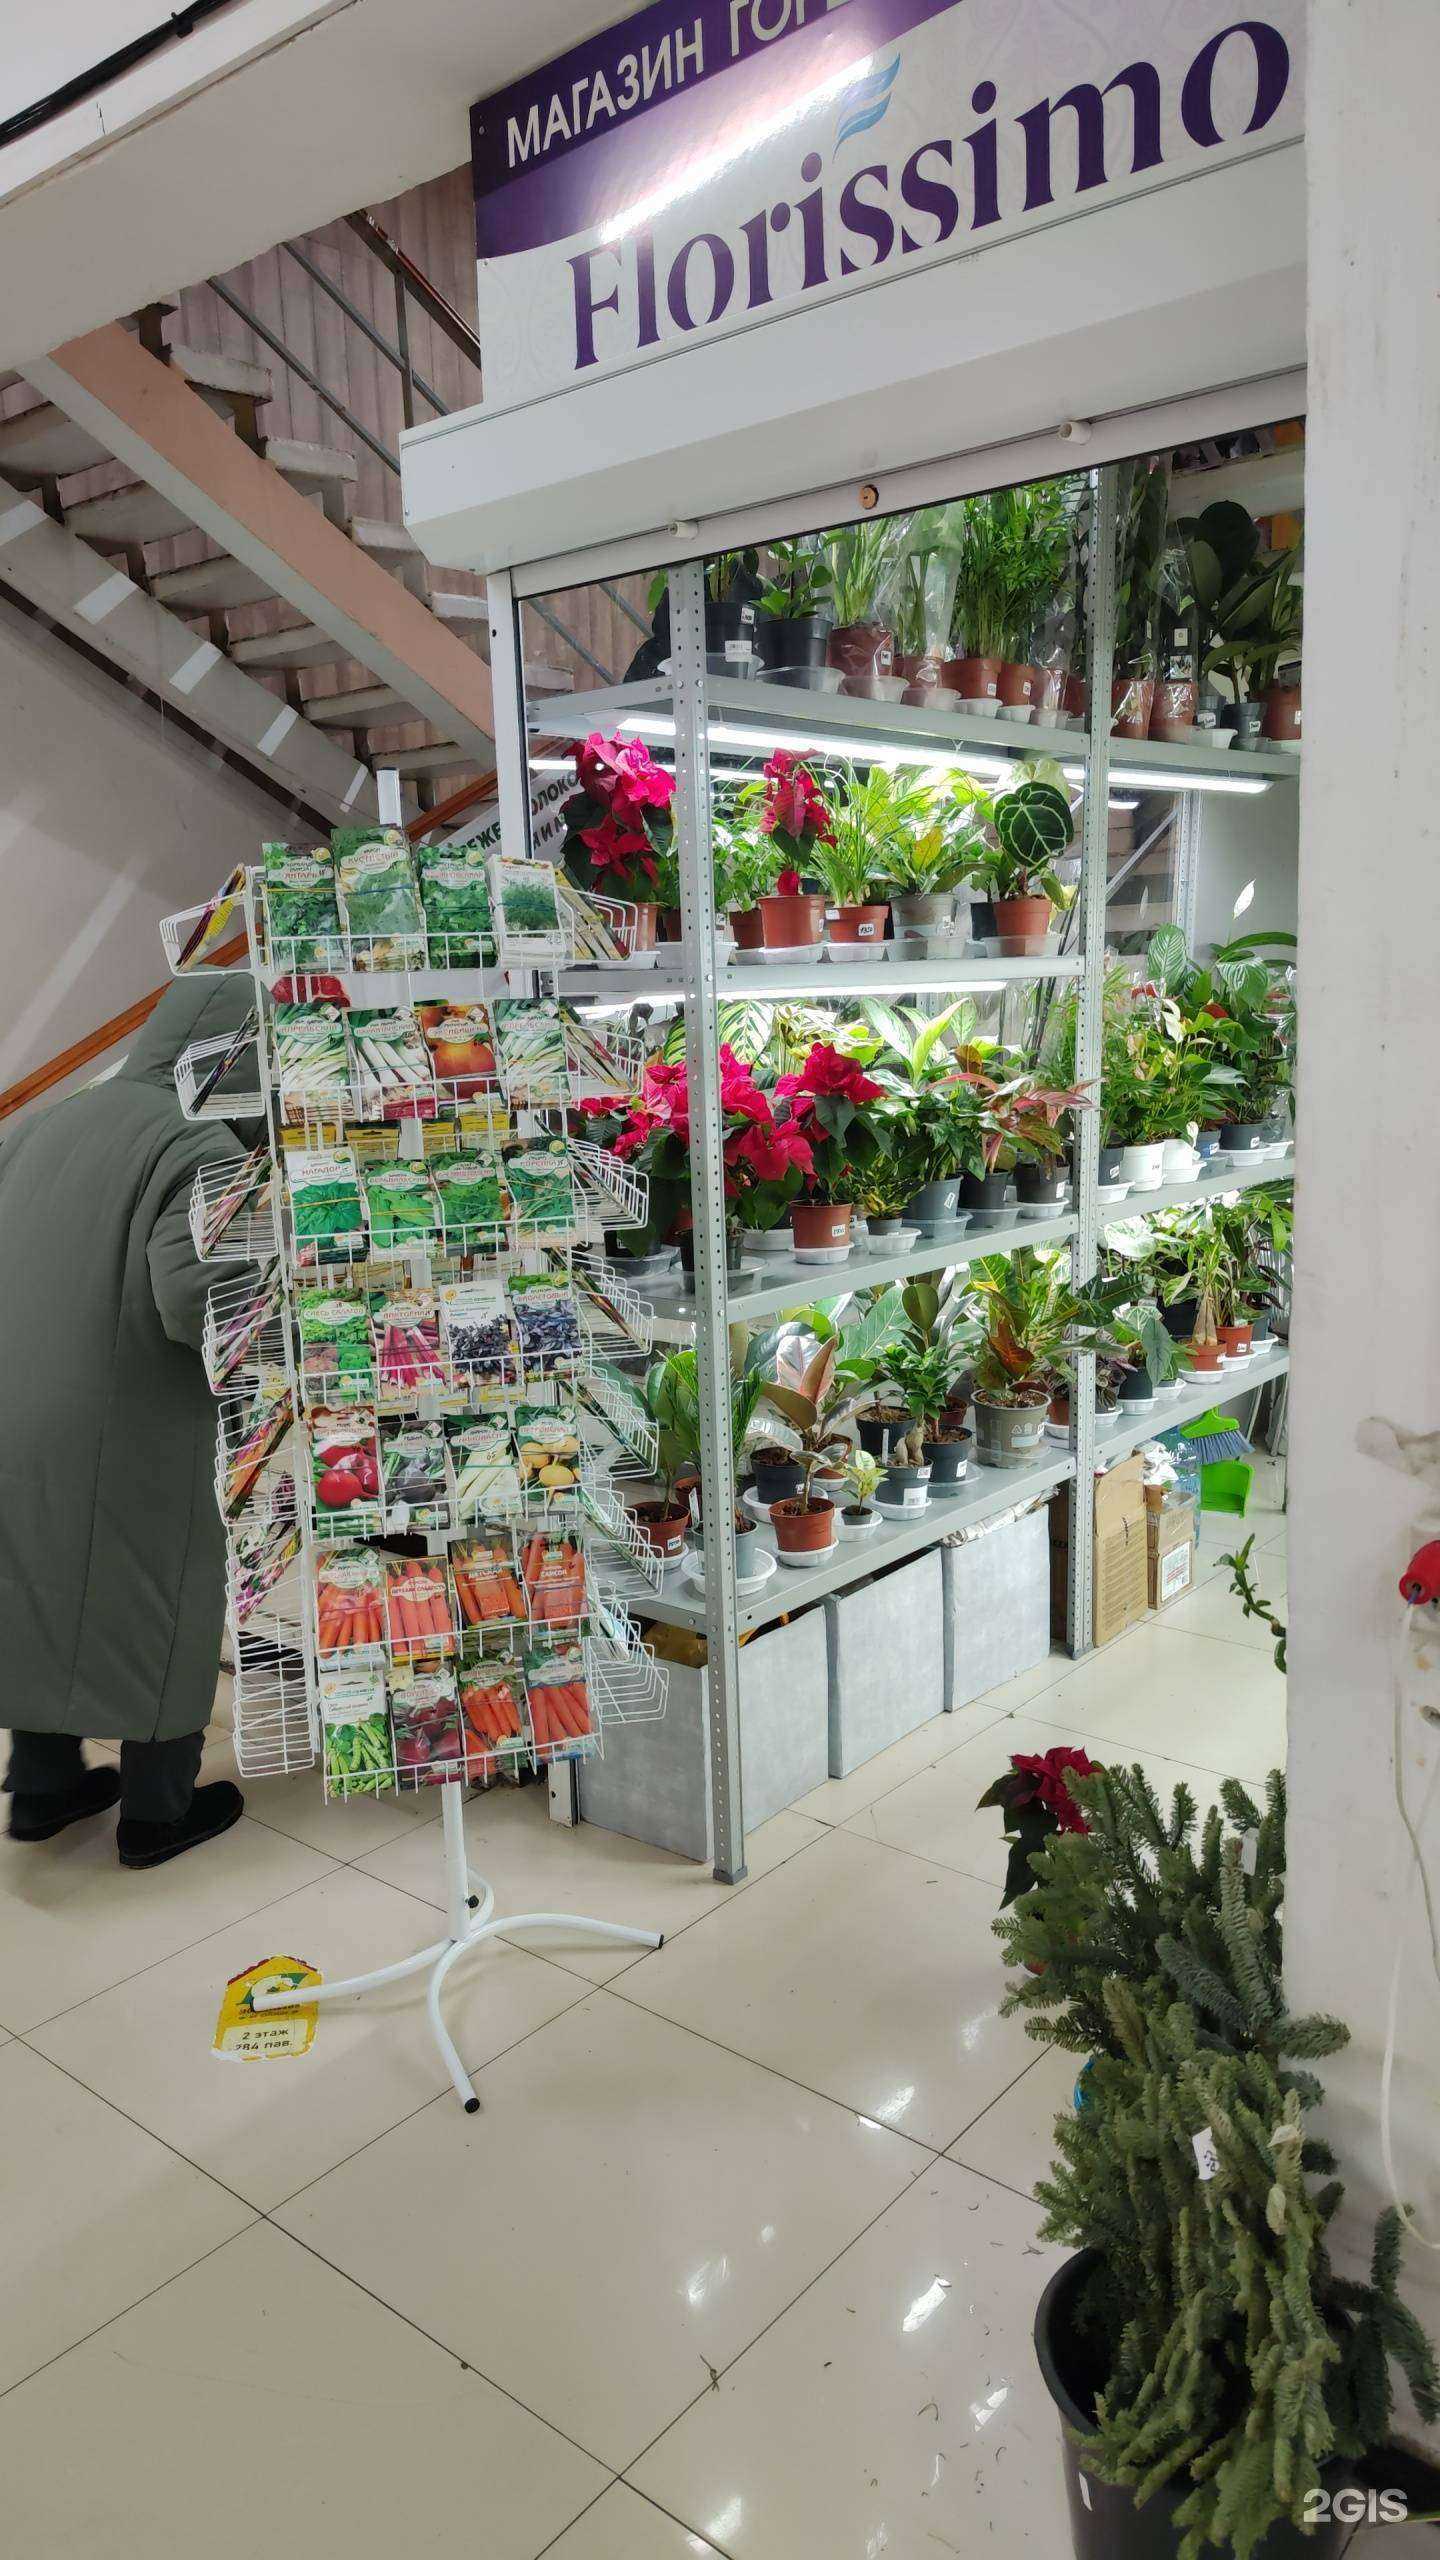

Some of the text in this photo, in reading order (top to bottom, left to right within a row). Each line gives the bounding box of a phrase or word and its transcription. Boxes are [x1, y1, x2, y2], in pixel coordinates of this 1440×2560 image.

[506, 18, 704, 168] МАГАЗИН
[566, 21, 1290, 369] Florissimo
[243, 2029, 289, 2040] 2 этаж
